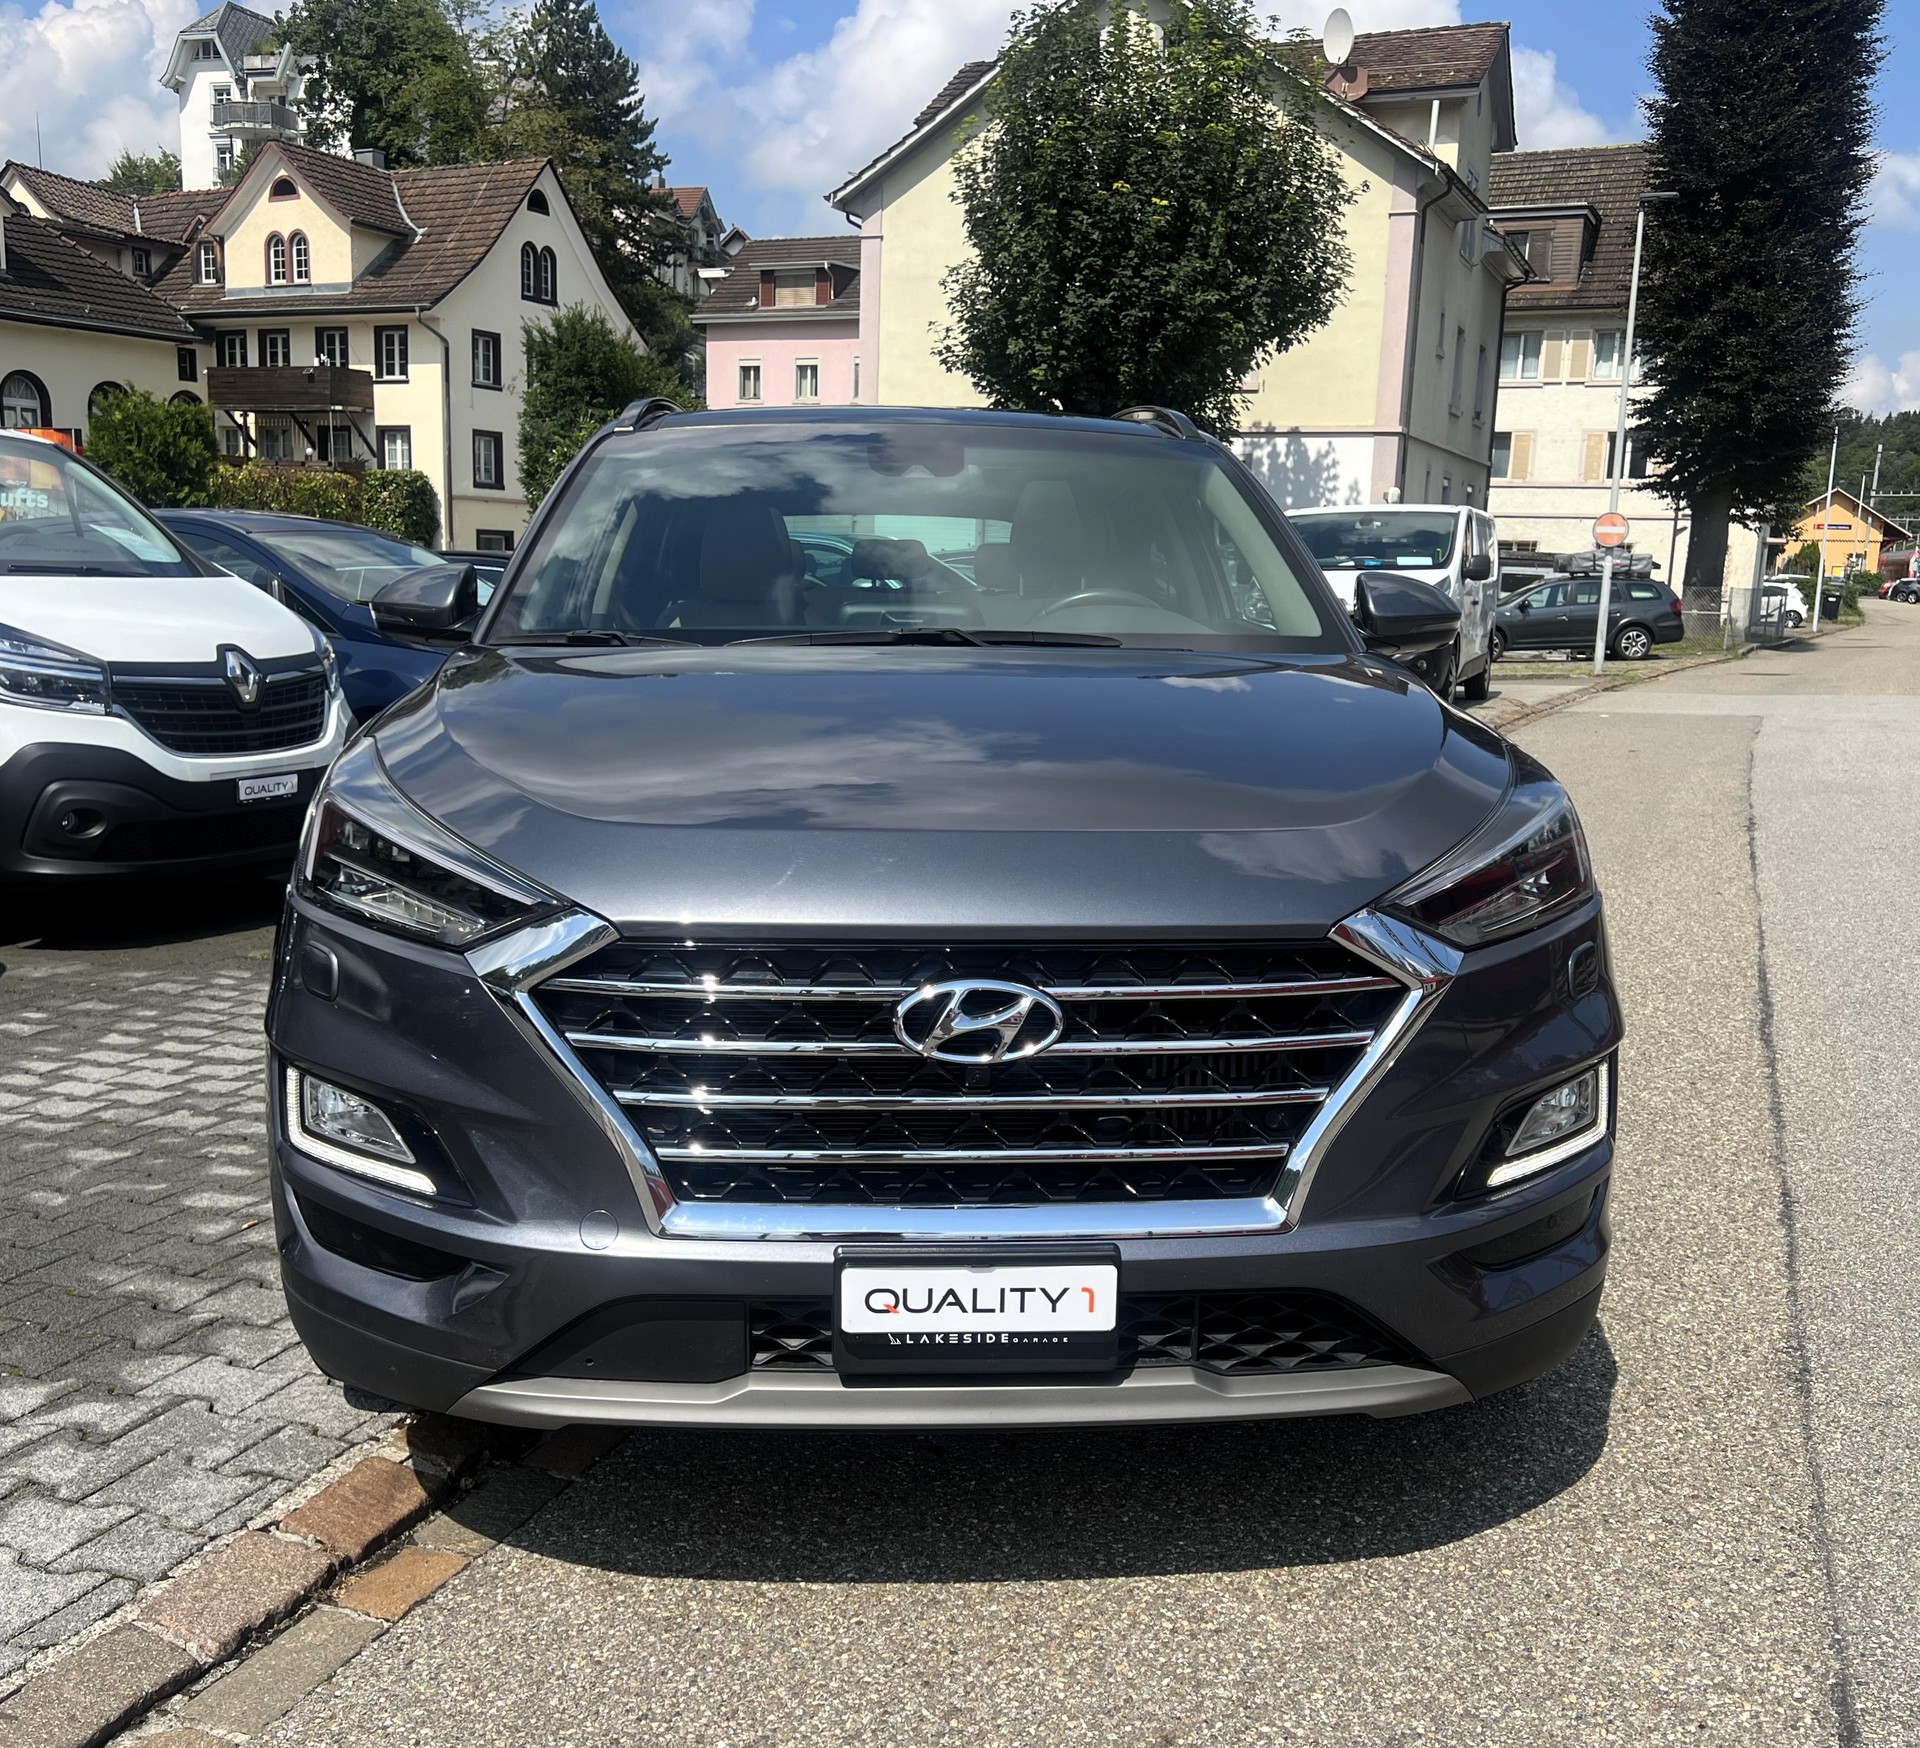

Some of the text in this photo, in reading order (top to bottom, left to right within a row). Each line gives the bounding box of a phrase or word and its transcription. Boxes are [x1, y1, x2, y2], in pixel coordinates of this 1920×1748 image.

[244, 782, 288, 795] QUALITY
[864, 1287, 1095, 1314] QUALITY 1
[906, 1333, 1009, 1344] LAKESIDE
